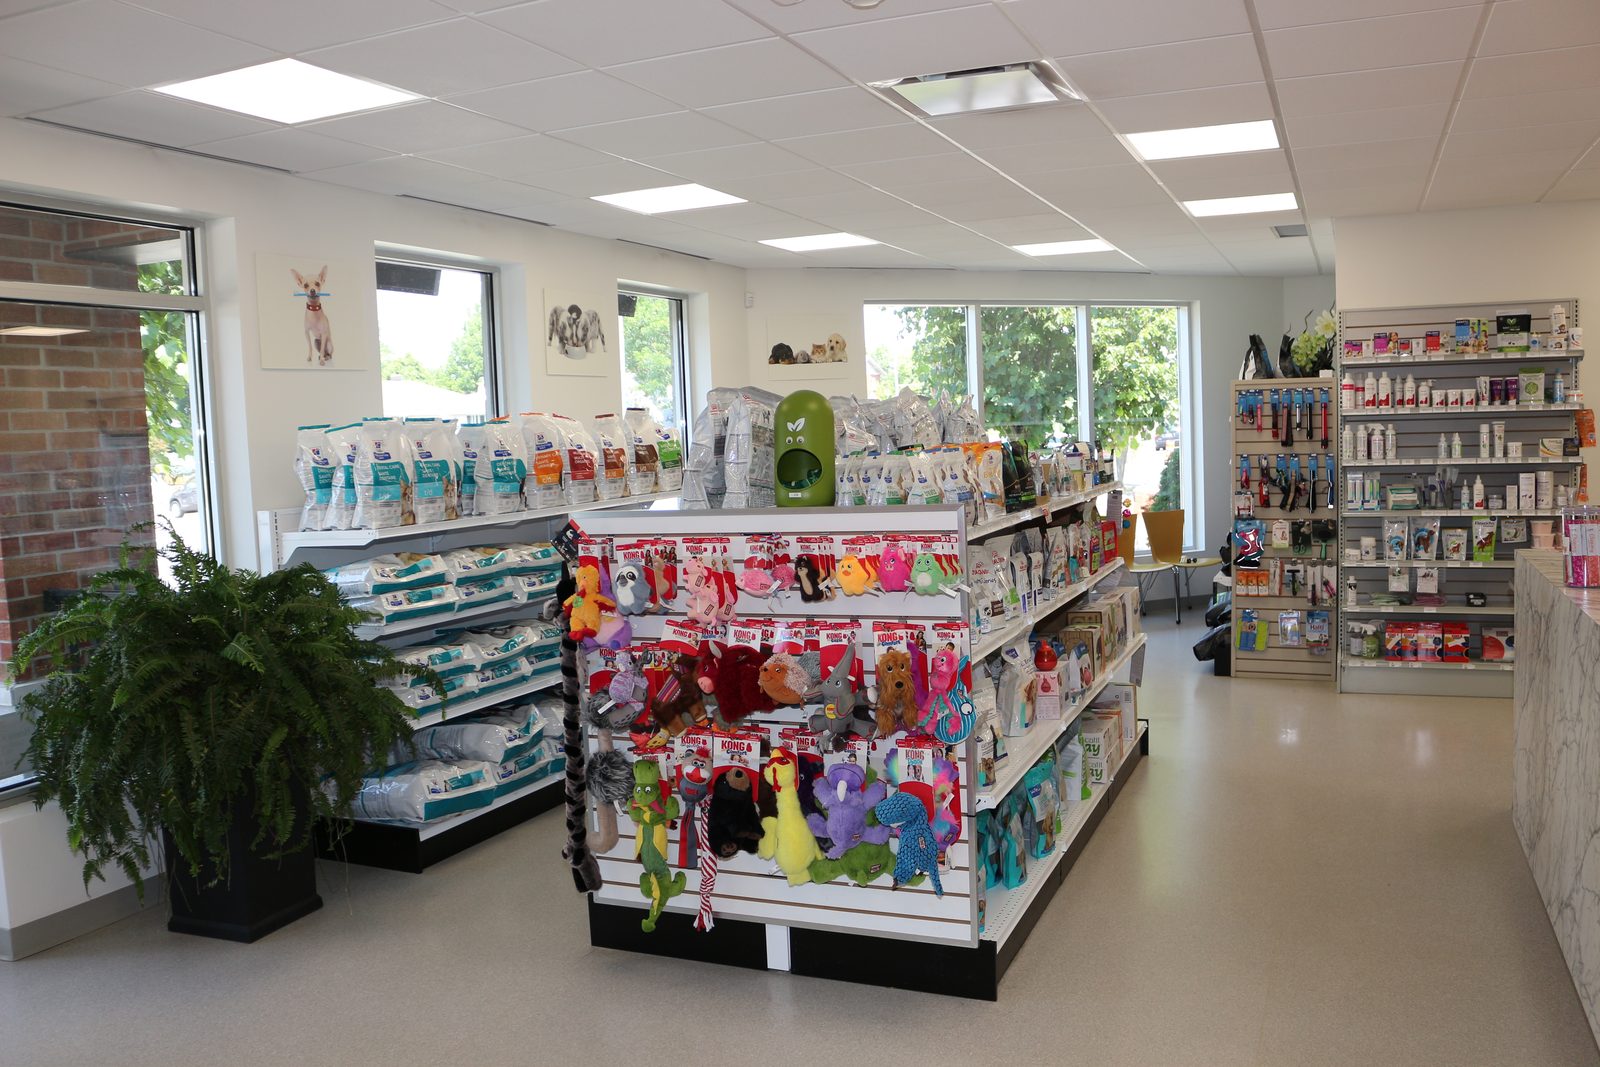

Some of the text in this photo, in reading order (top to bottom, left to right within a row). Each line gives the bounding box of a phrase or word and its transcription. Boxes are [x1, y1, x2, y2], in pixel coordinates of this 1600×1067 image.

[623, 551, 640, 560] KONG
[673, 629, 688, 638] KONG
[733, 630, 751, 640] KONG
[877, 633, 898, 642] KONG
[681, 736, 701, 745] KONG
[721, 740, 745, 751] KONG
[905, 750, 925, 760] KONG
